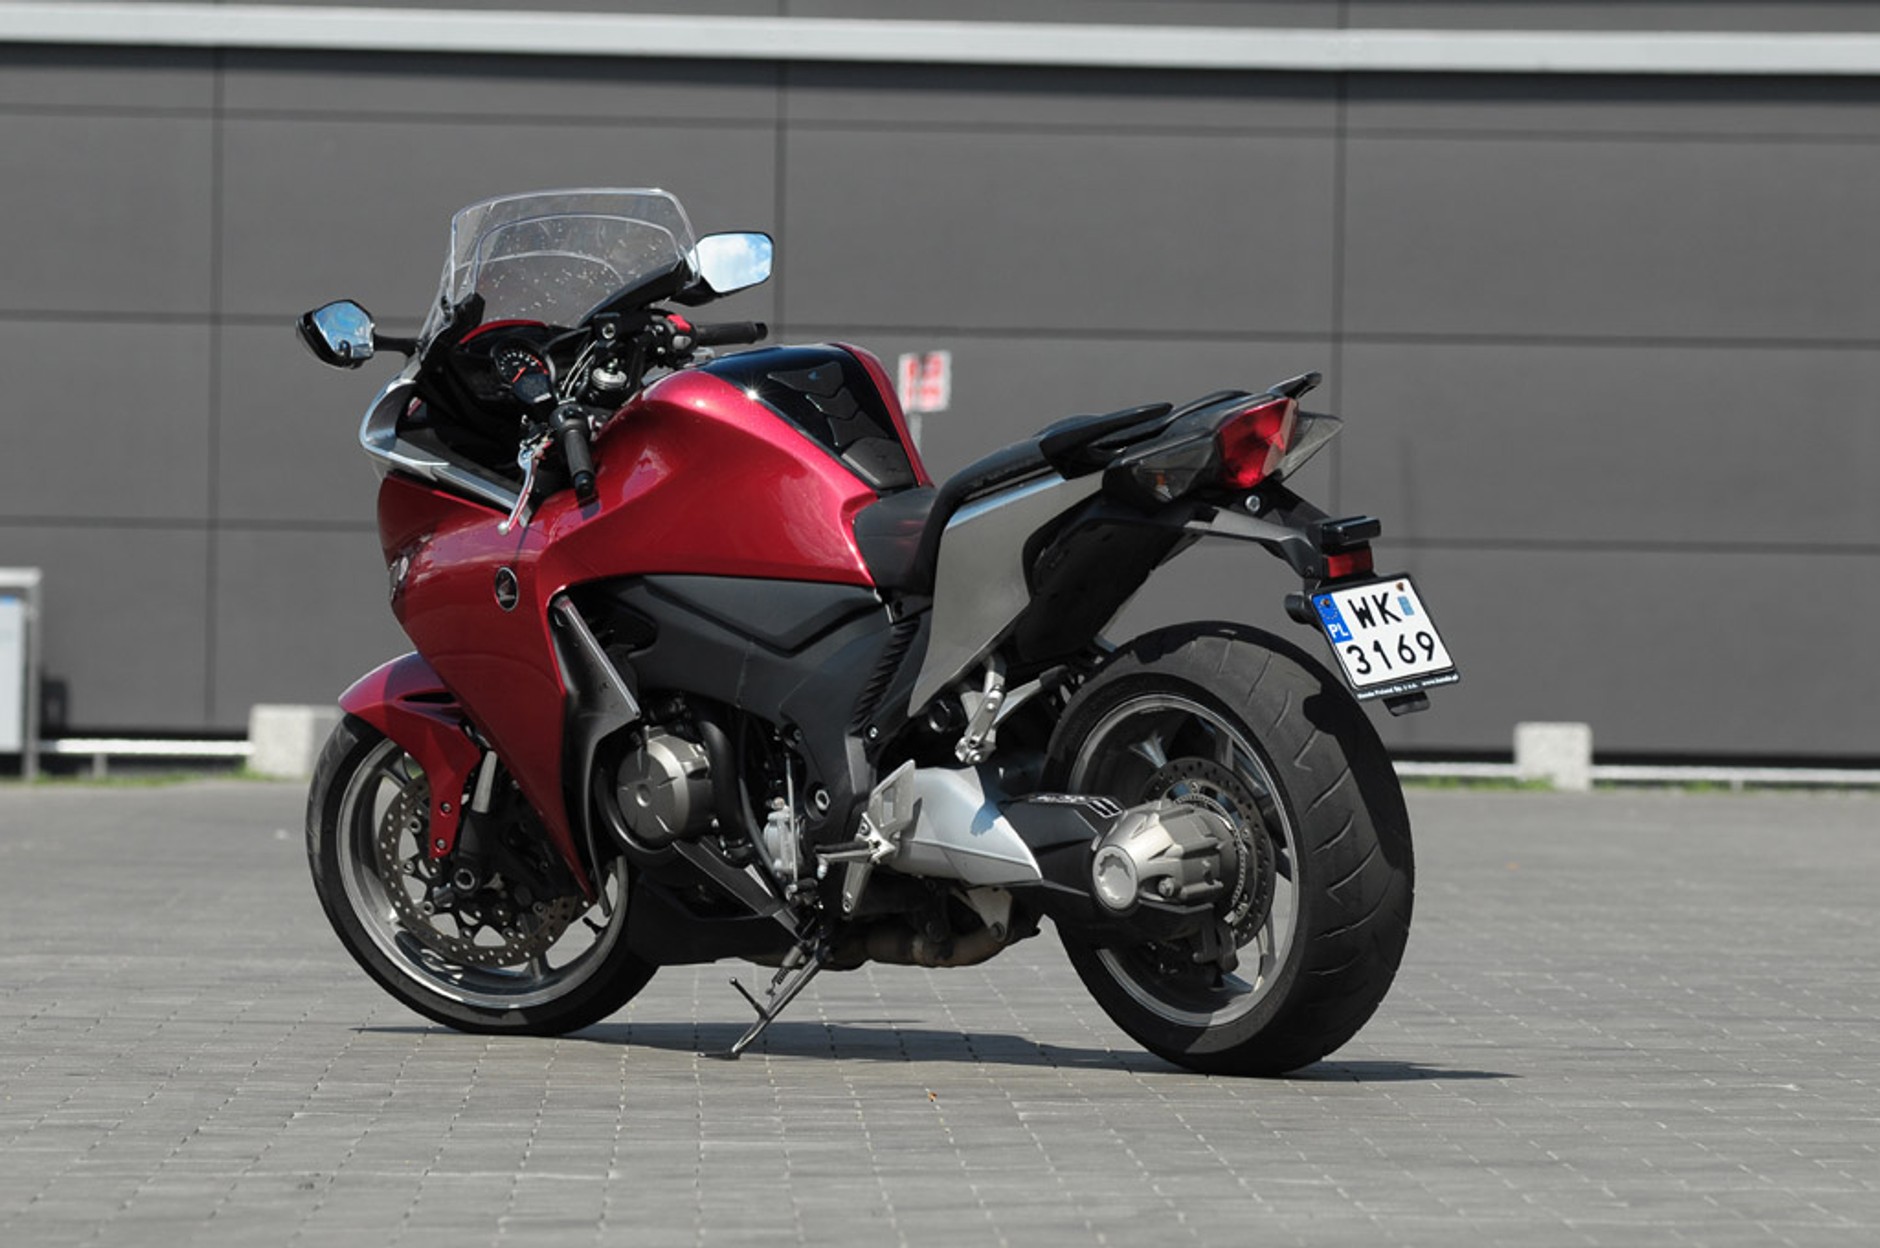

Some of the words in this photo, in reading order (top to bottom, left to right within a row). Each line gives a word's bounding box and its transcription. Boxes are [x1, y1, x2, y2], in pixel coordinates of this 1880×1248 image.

[1347, 592, 1402, 629] WK
[1327, 623, 1350, 639] PL
[1346, 631, 1435, 675] 3169
